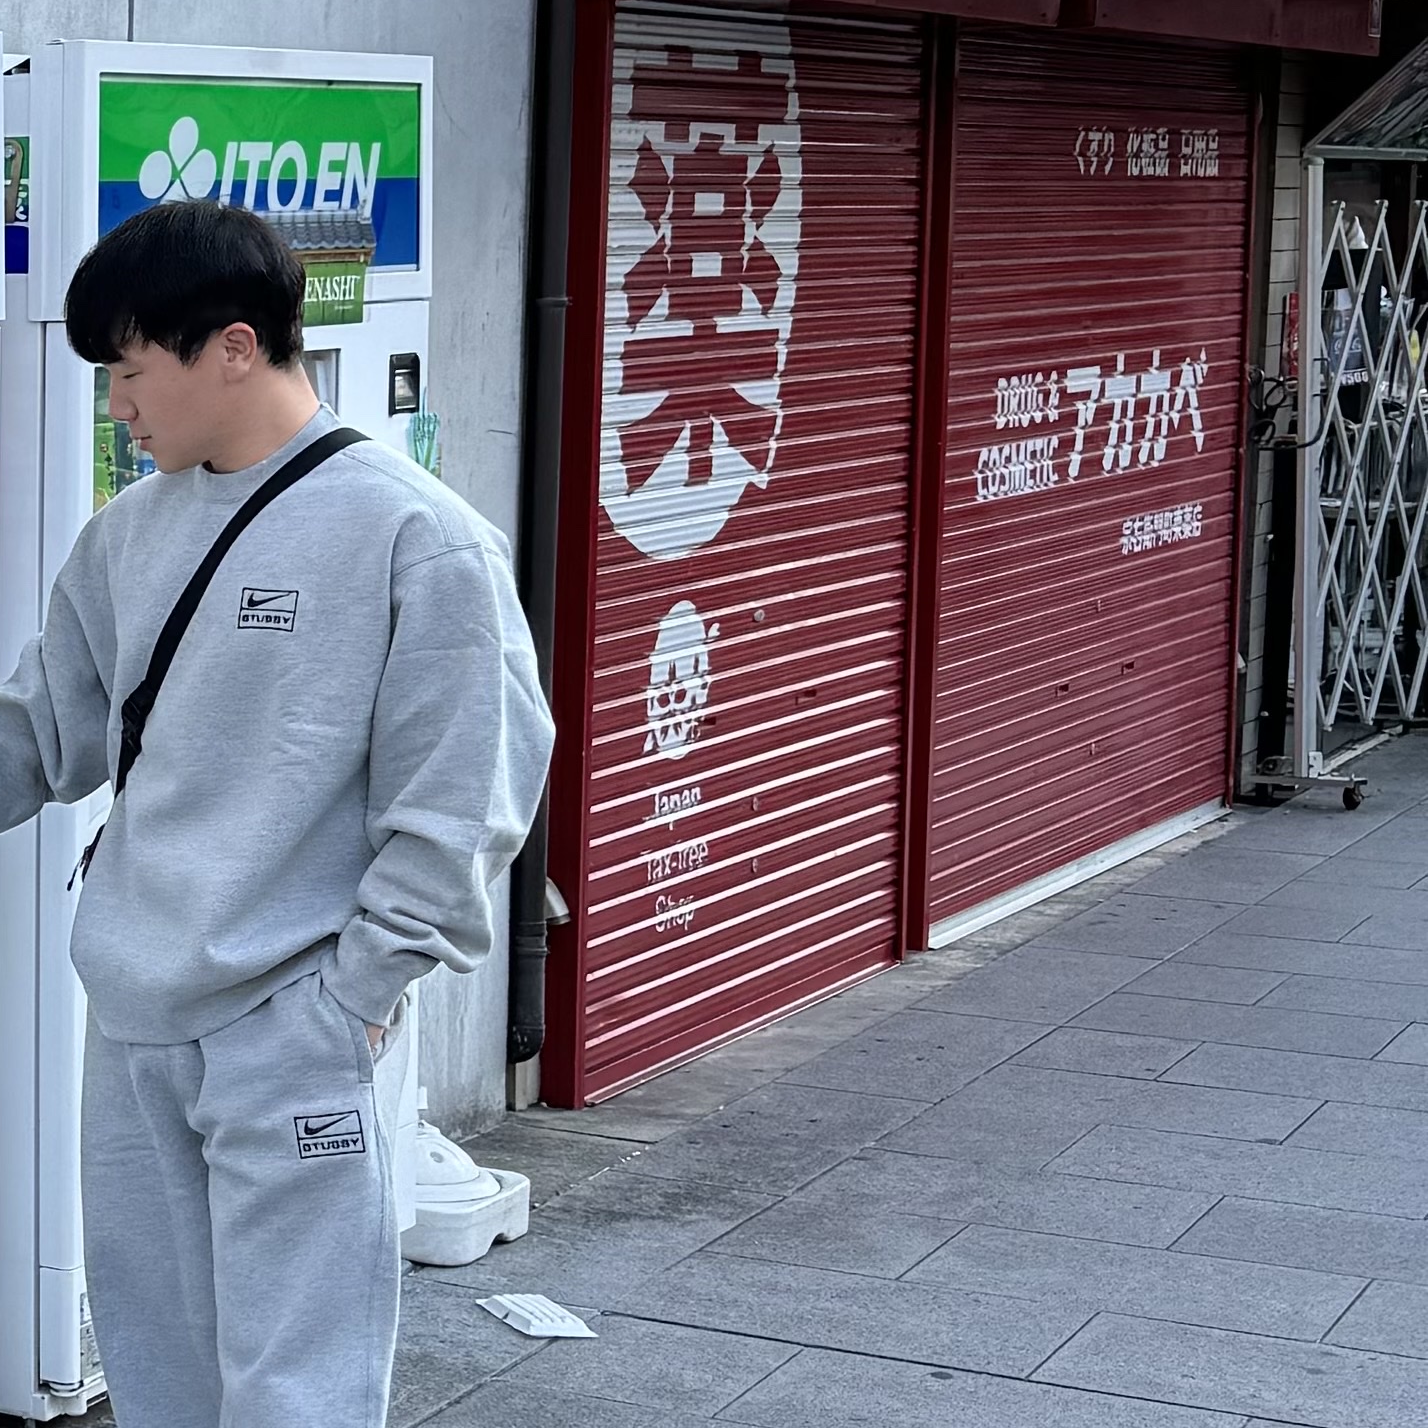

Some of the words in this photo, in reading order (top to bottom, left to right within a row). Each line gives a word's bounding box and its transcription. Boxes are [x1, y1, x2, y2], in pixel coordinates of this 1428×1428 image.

[218, 139, 308, 213] ITO
[312, 141, 382, 223] EN
[1074, 127, 1116, 176] くすり
[303, 273, 358, 302] ENASHI
[995, 371, 1044, 429] DRUG
[1046, 369, 1060, 423] &
[1064, 346, 1209, 481] アカカベ
[975, 434, 1060, 501] COSMETIC
